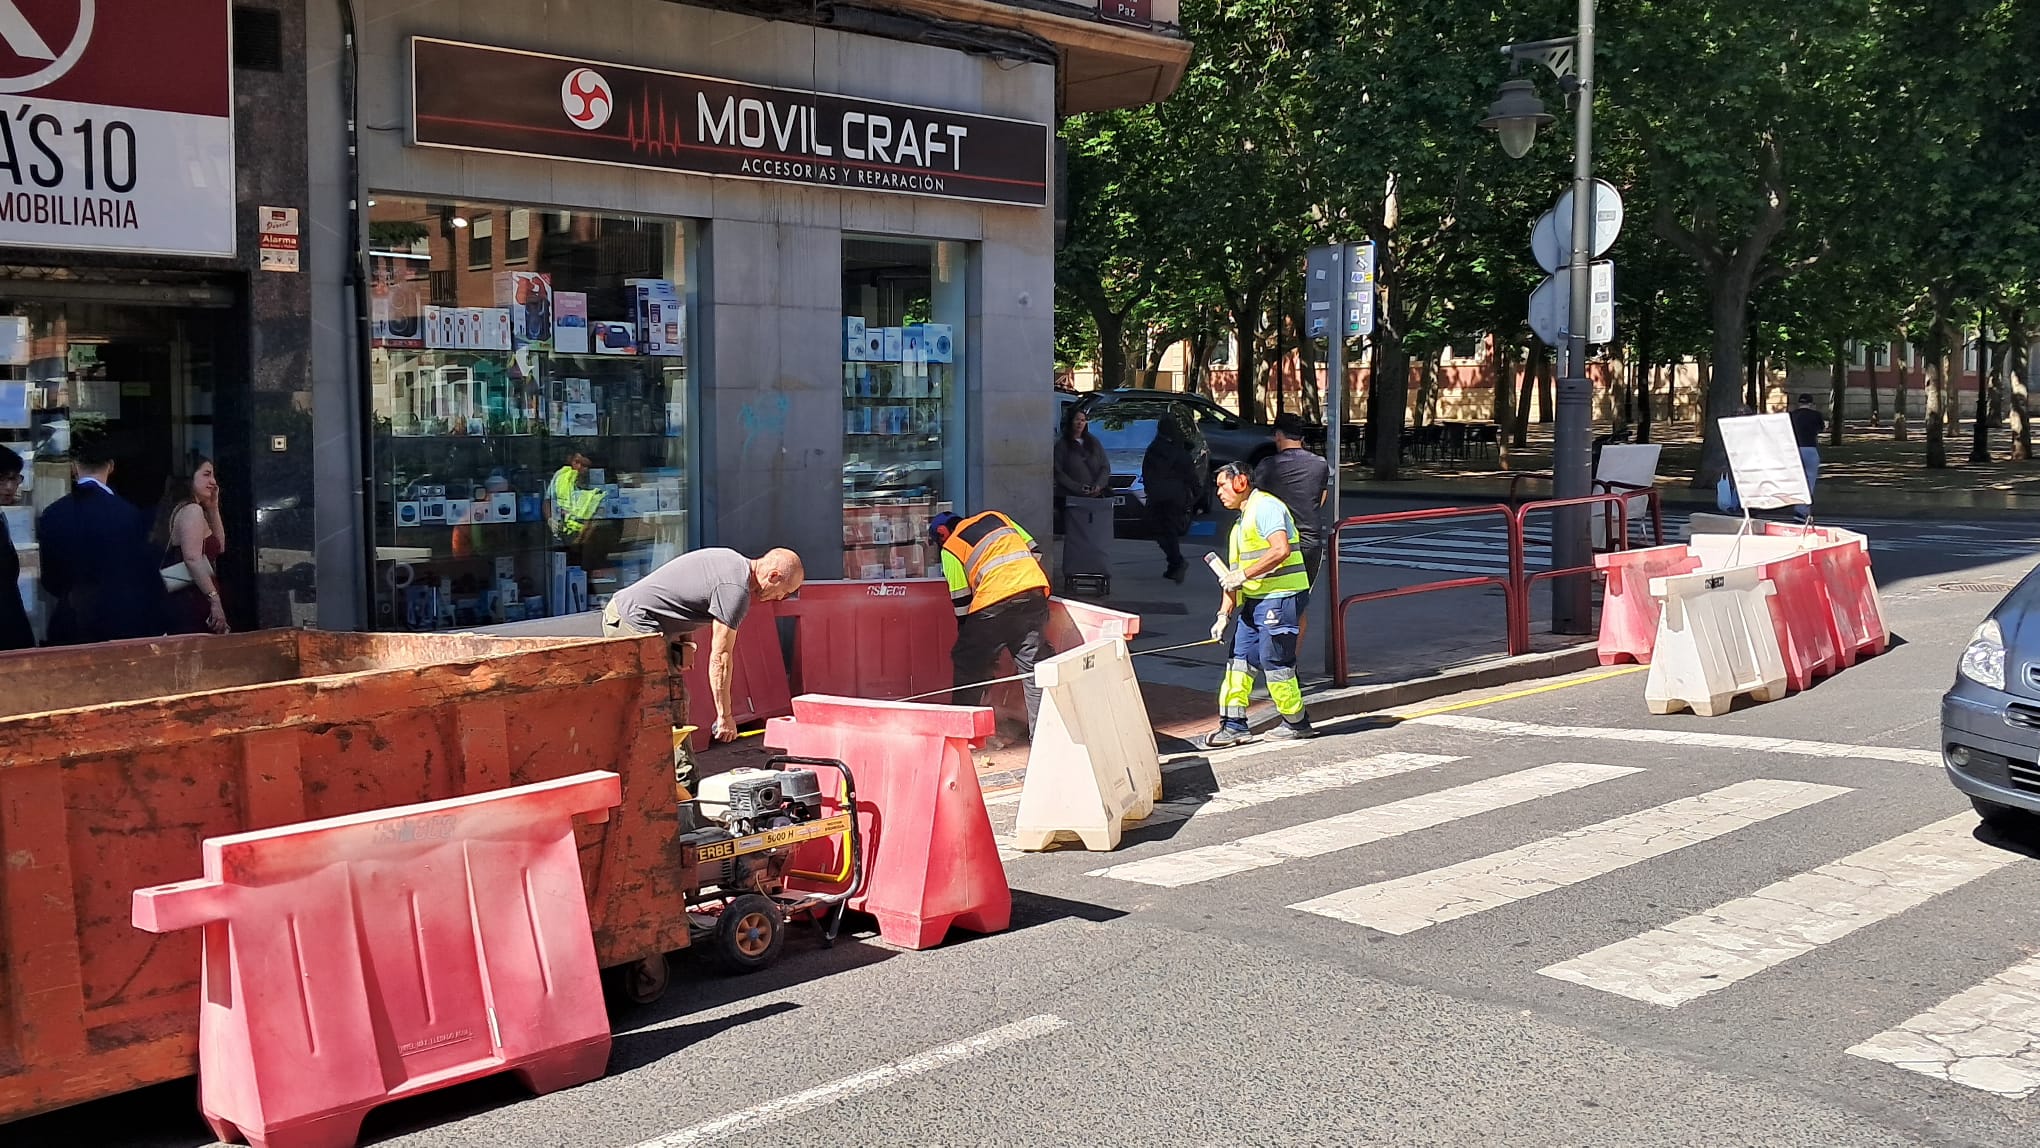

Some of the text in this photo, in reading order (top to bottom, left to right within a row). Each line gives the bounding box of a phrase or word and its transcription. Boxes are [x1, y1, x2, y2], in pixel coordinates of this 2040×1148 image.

[1118, 3, 1136, 17] Paz
[697, 91, 968, 171] MOVIL CRAFT
[842, 167, 850, 180] Y
[858, 170, 945, 192] REPARACIÓN
[262, 235, 297, 246] Alarma
[697, 842, 733, 861] ERBE
